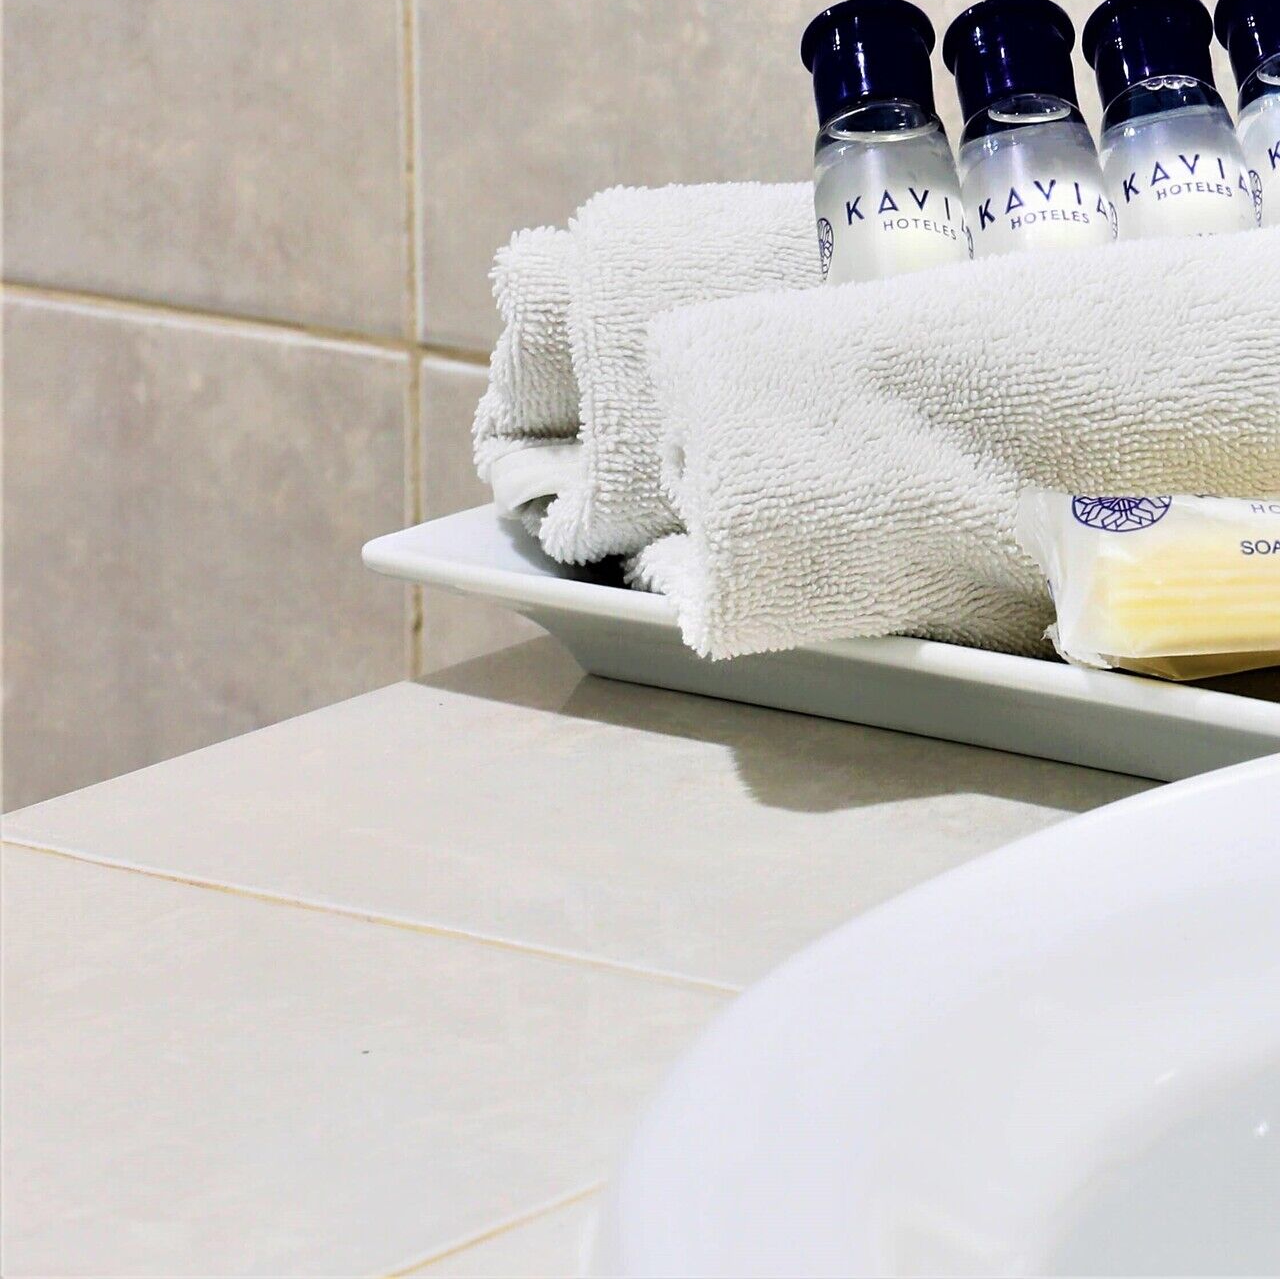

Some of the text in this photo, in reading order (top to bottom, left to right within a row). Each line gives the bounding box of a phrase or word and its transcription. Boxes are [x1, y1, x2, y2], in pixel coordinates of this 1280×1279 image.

[1156, 182, 1233, 201] HOTELES
[883, 217, 957, 241] HOTELES
[1010, 209, 1090, 230] HOTELES
